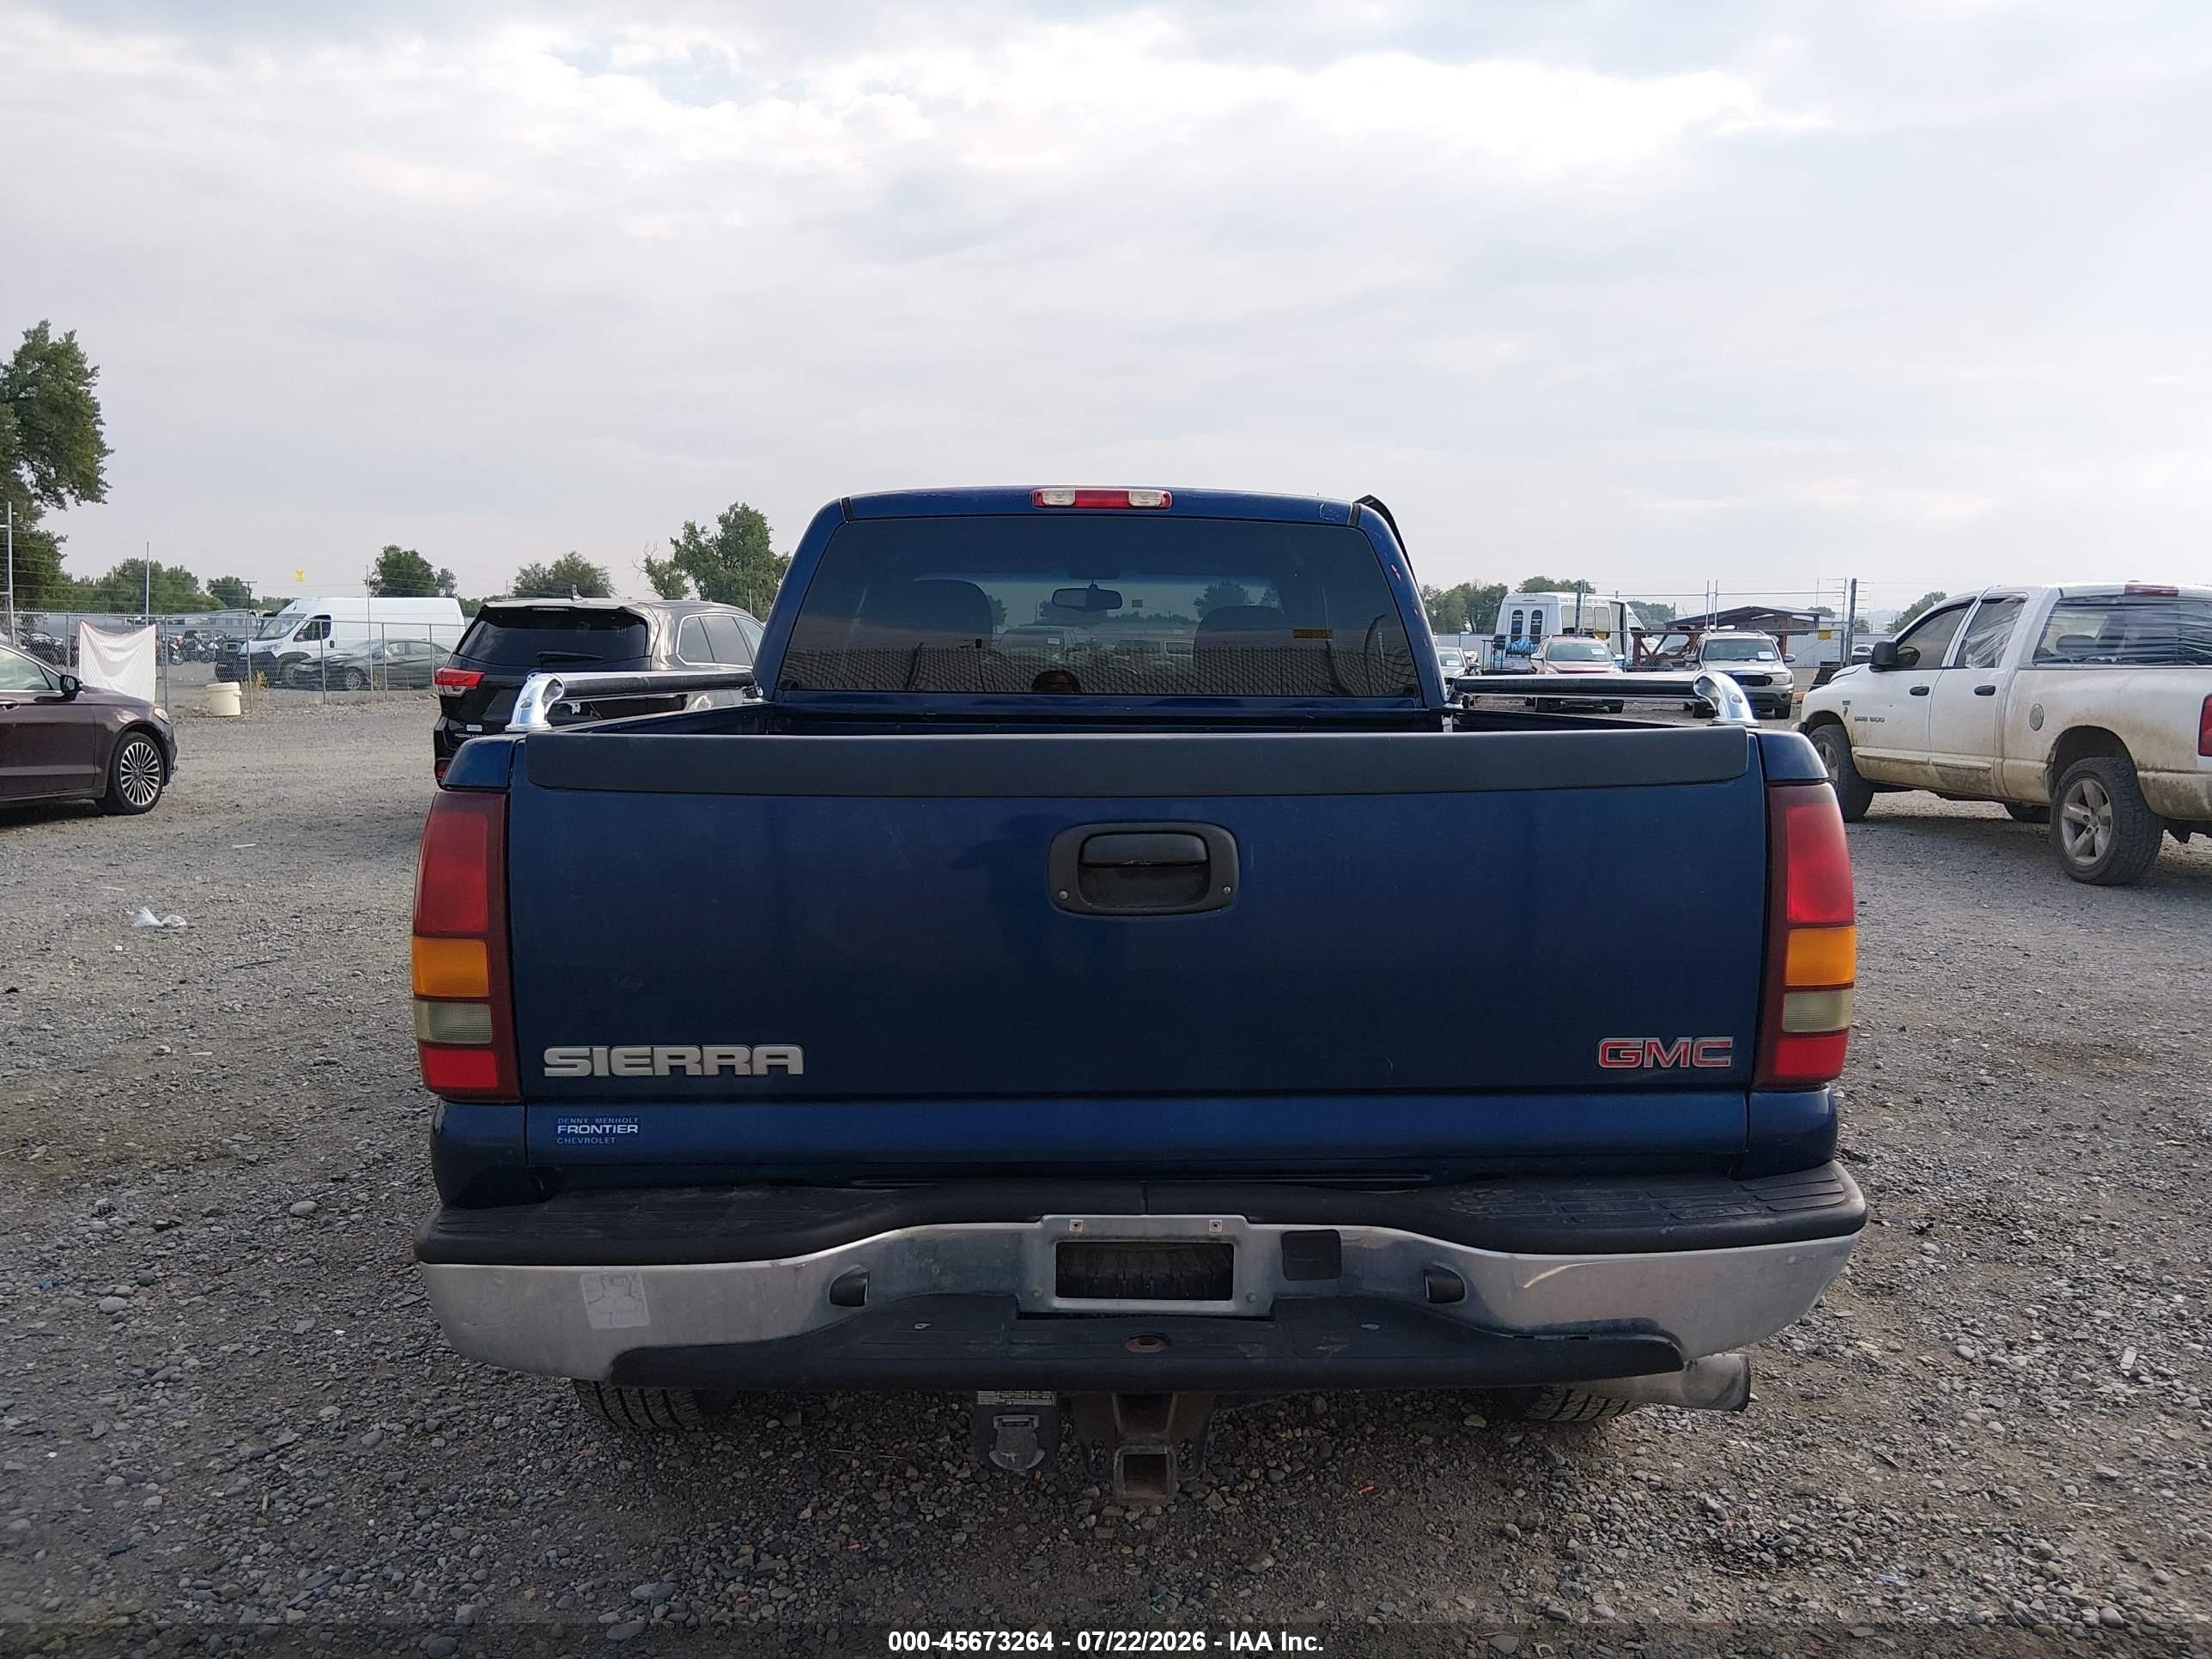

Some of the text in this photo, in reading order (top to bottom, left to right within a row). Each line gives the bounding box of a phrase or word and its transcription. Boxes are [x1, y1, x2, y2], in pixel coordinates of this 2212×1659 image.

[544, 1044, 804, 1077] SIERRA
[1597, 1036, 1734, 1068] GMC
[557, 1124, 639, 1133] FRONTIER
